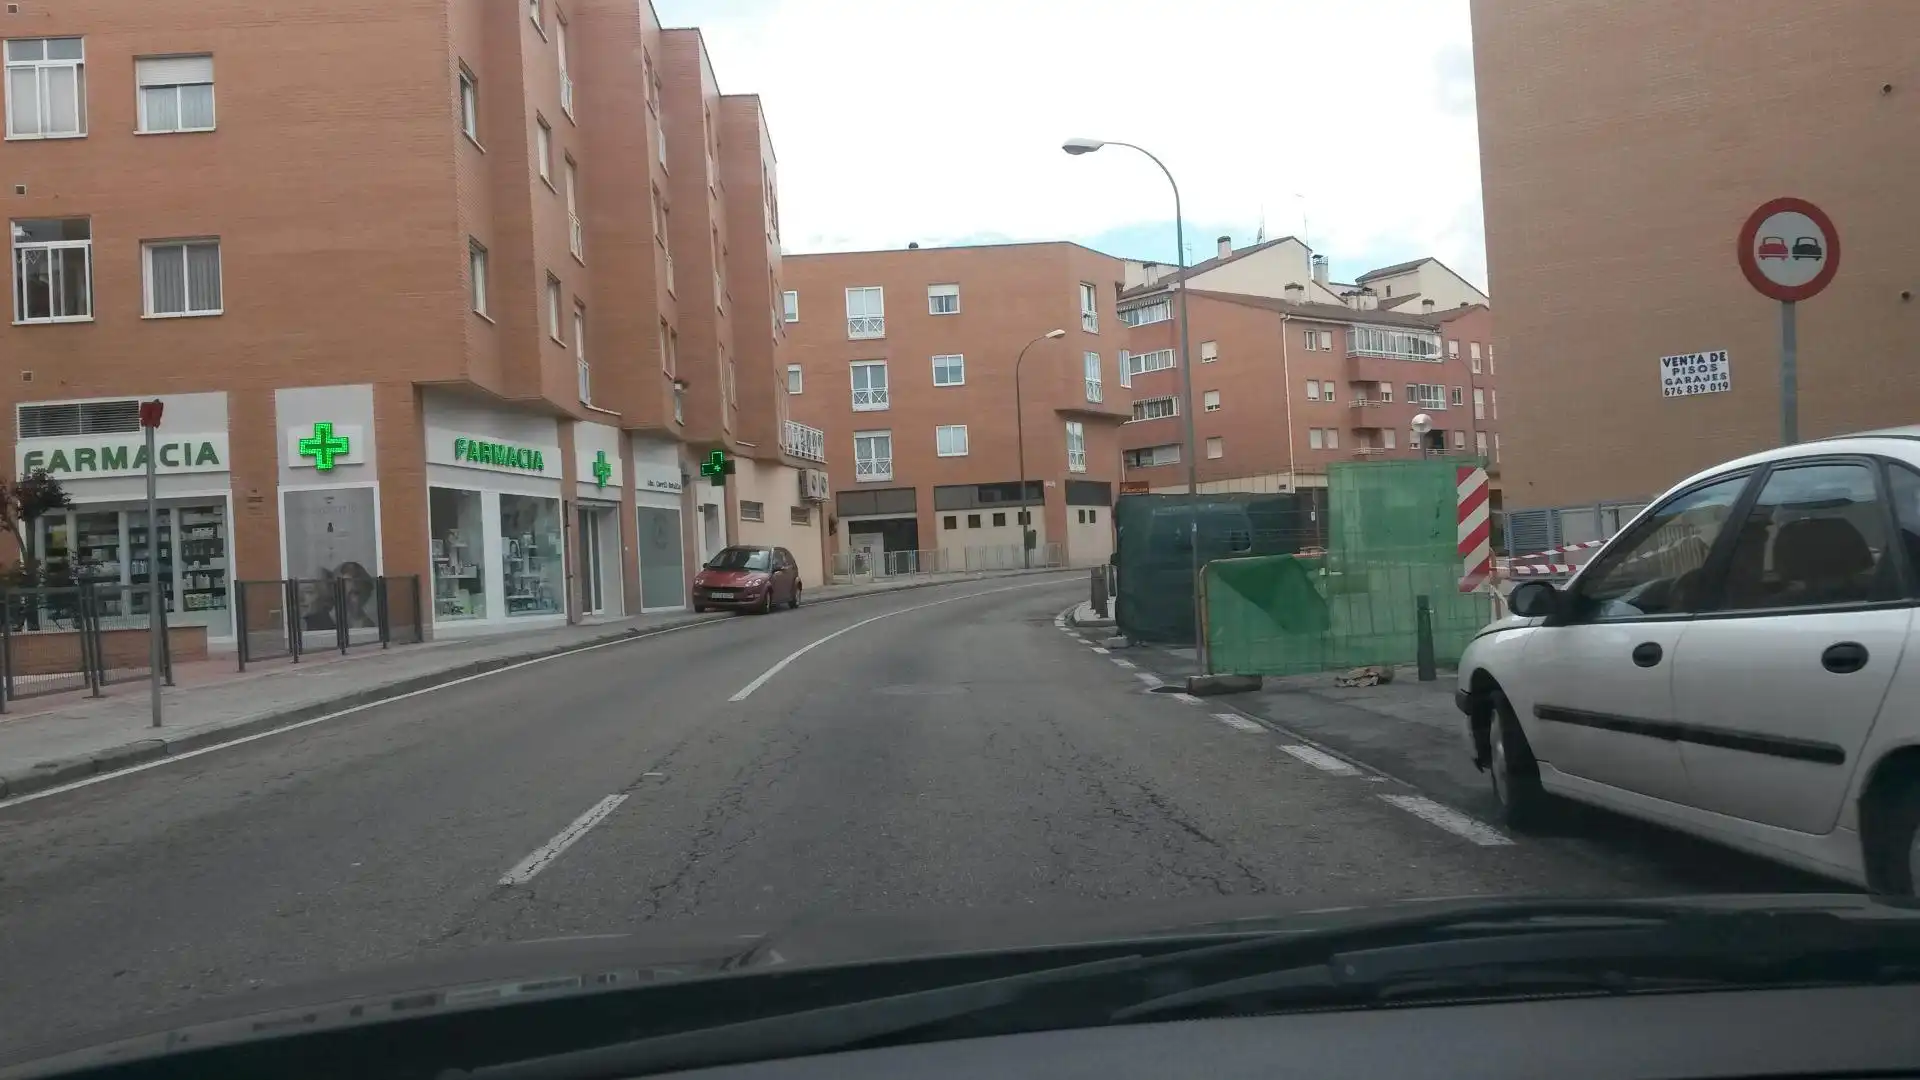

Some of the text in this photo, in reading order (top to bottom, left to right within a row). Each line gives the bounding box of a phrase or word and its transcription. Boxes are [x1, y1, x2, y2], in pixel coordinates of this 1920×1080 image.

[1662, 352, 1726, 367] VENTA DE
[1672, 364, 1718, 376] PISOS
[1665, 373, 1727, 385] GARAJES
[1664, 382, 1728, 396] 676 839 019
[24, 442, 220, 474] FARMACIA
[455, 437, 544, 471] FARMACIA
